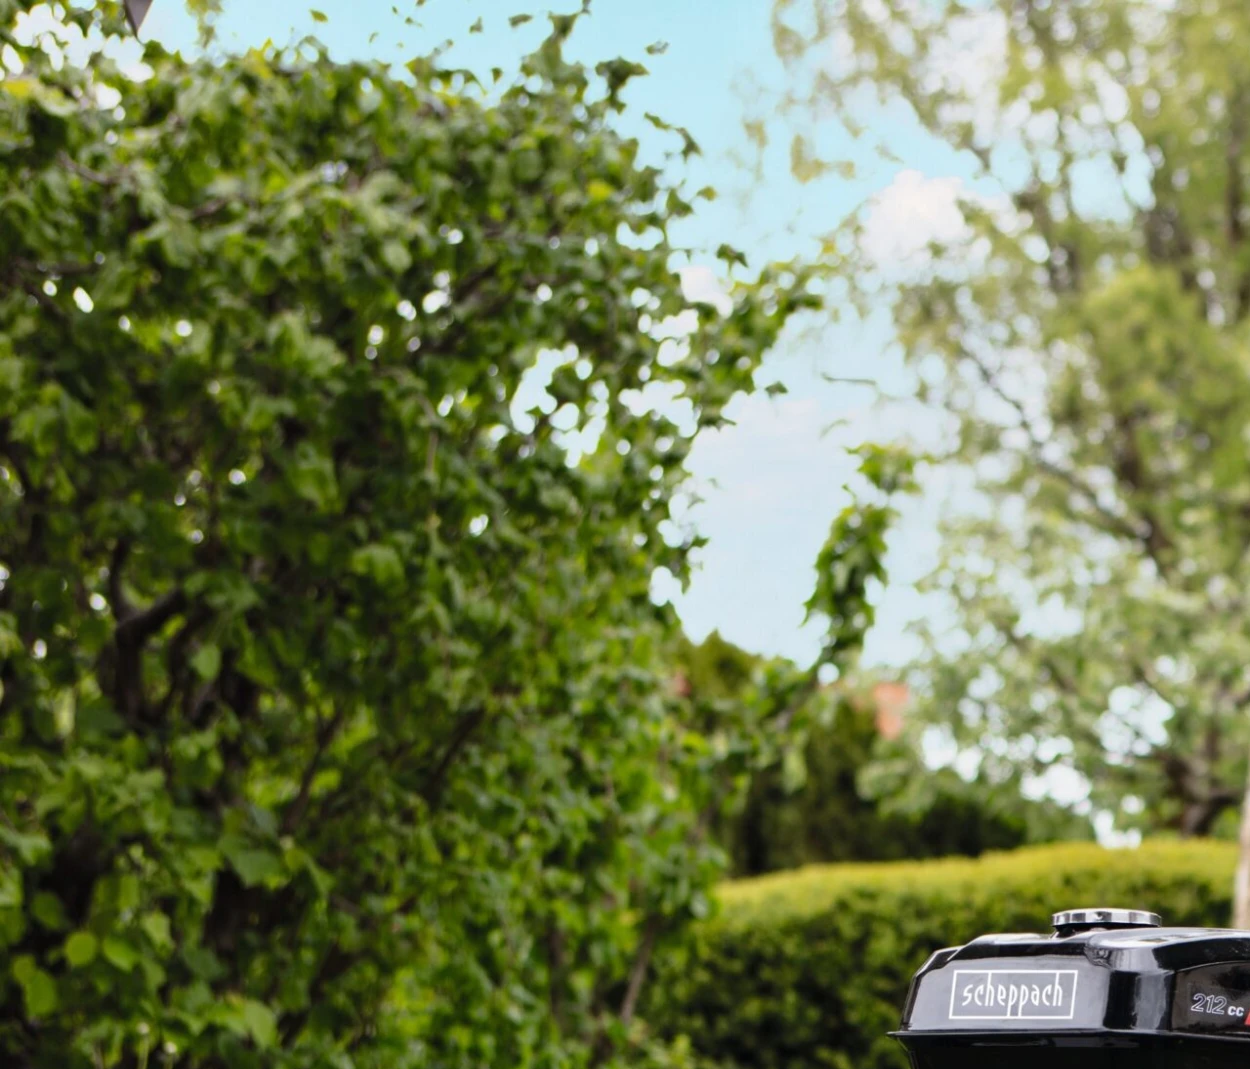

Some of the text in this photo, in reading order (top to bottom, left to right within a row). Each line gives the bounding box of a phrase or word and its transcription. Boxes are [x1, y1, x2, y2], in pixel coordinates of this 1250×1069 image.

[962, 970, 1063, 1018] scheppach
[1190, 993, 1245, 1017] 212 cc
